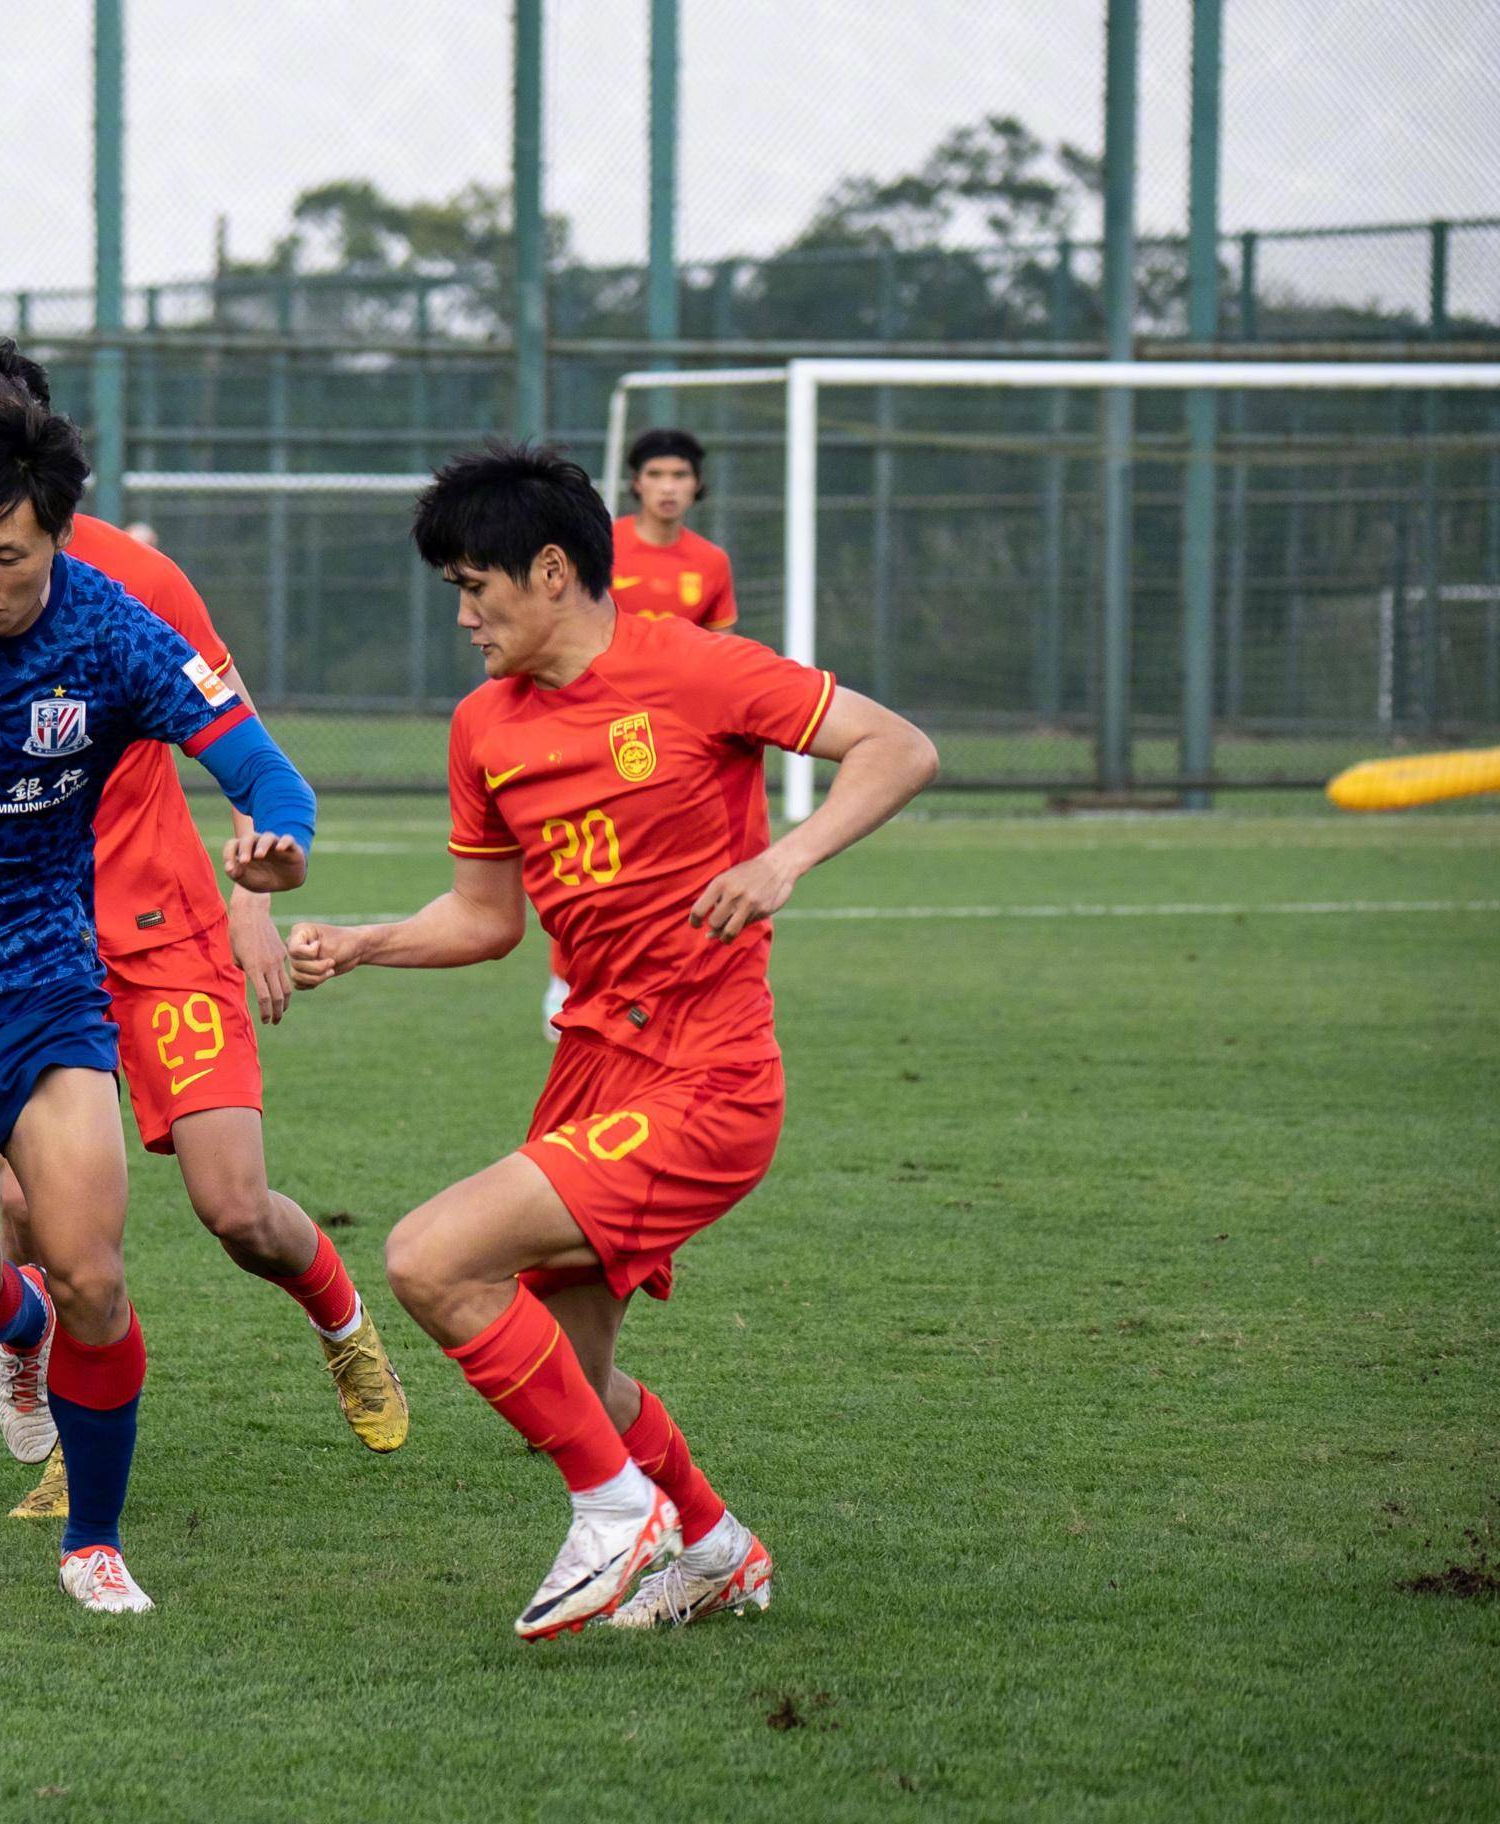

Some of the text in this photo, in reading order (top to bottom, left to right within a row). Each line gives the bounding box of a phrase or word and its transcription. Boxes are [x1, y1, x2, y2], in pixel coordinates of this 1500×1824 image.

[613, 717, 646, 737] CFA
[542, 809, 621, 886] 20
[152, 992, 225, 1070] 29
